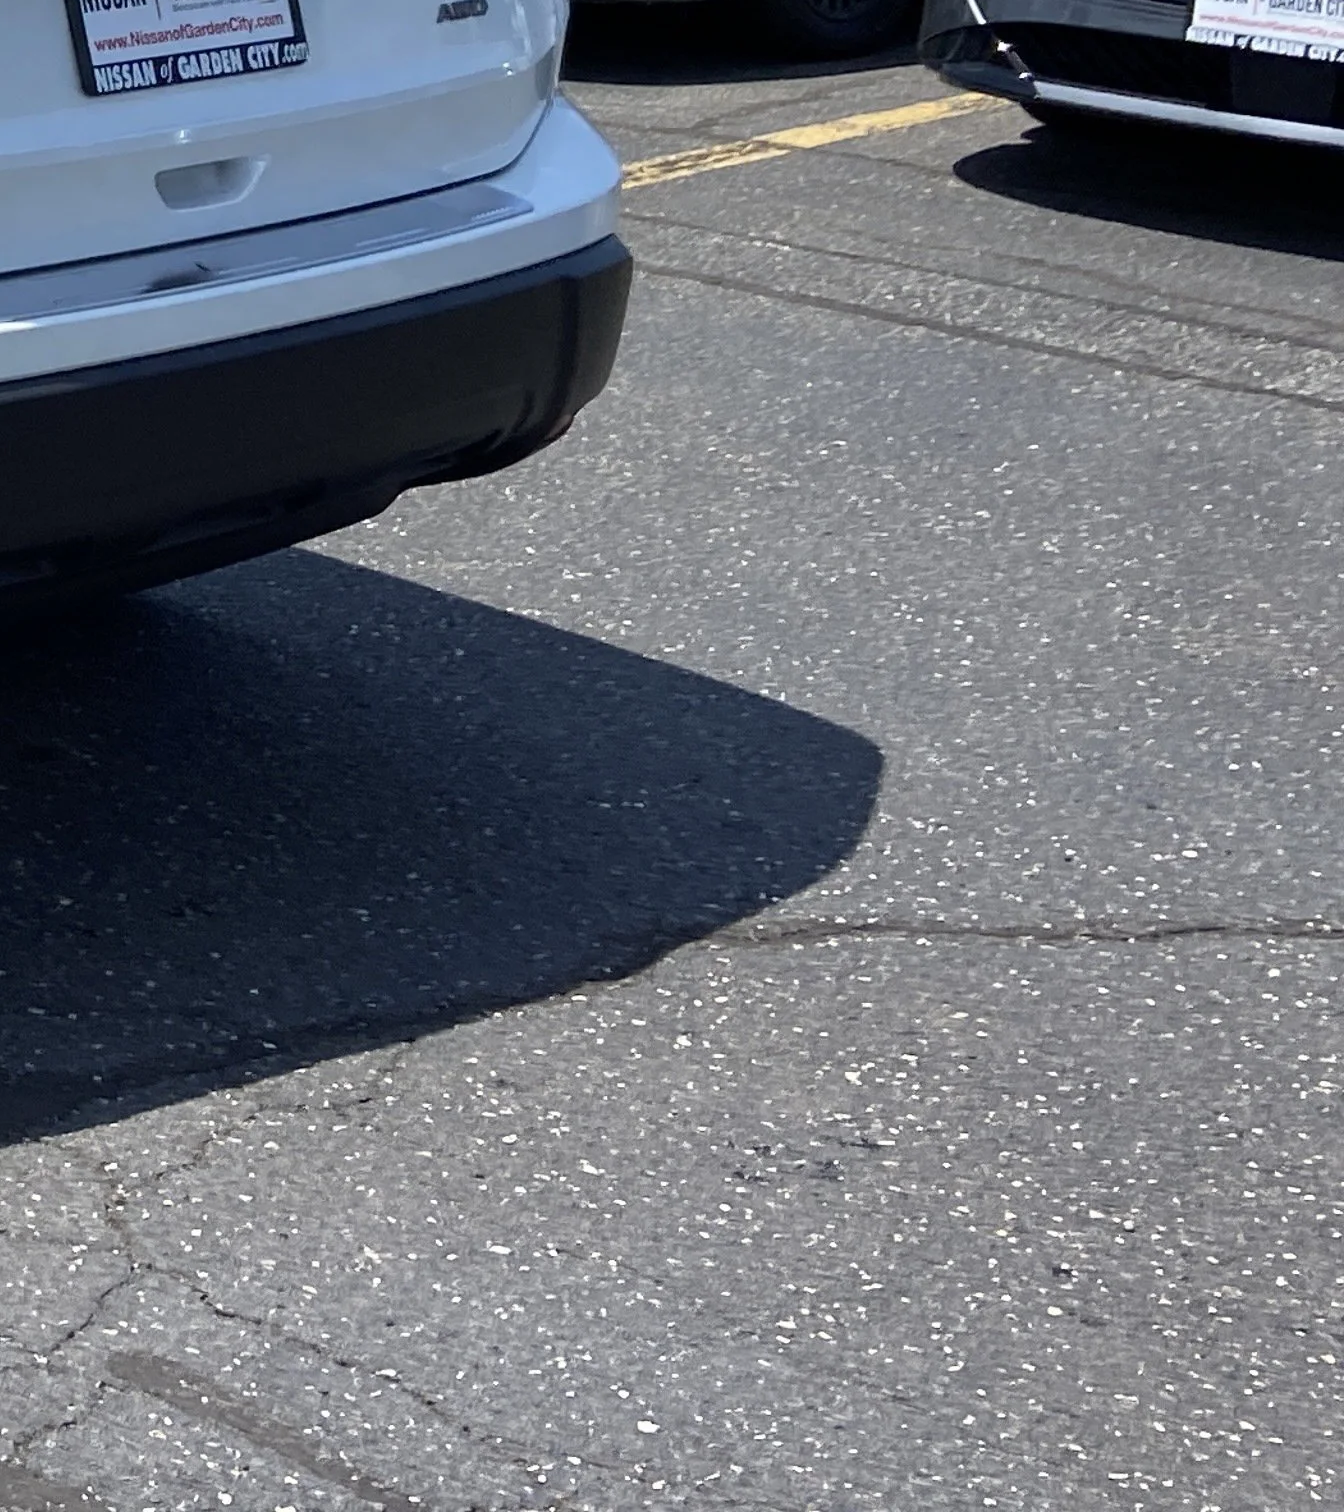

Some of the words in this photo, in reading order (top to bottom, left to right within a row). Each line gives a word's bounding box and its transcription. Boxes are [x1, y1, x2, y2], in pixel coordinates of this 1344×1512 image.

[94, 13, 285, 53] www.NissanofGardenCity.com
[94, 59, 158, 93] NISSAN
[160, 55, 175, 84] of
[177, 47, 244, 81] GARDEN
